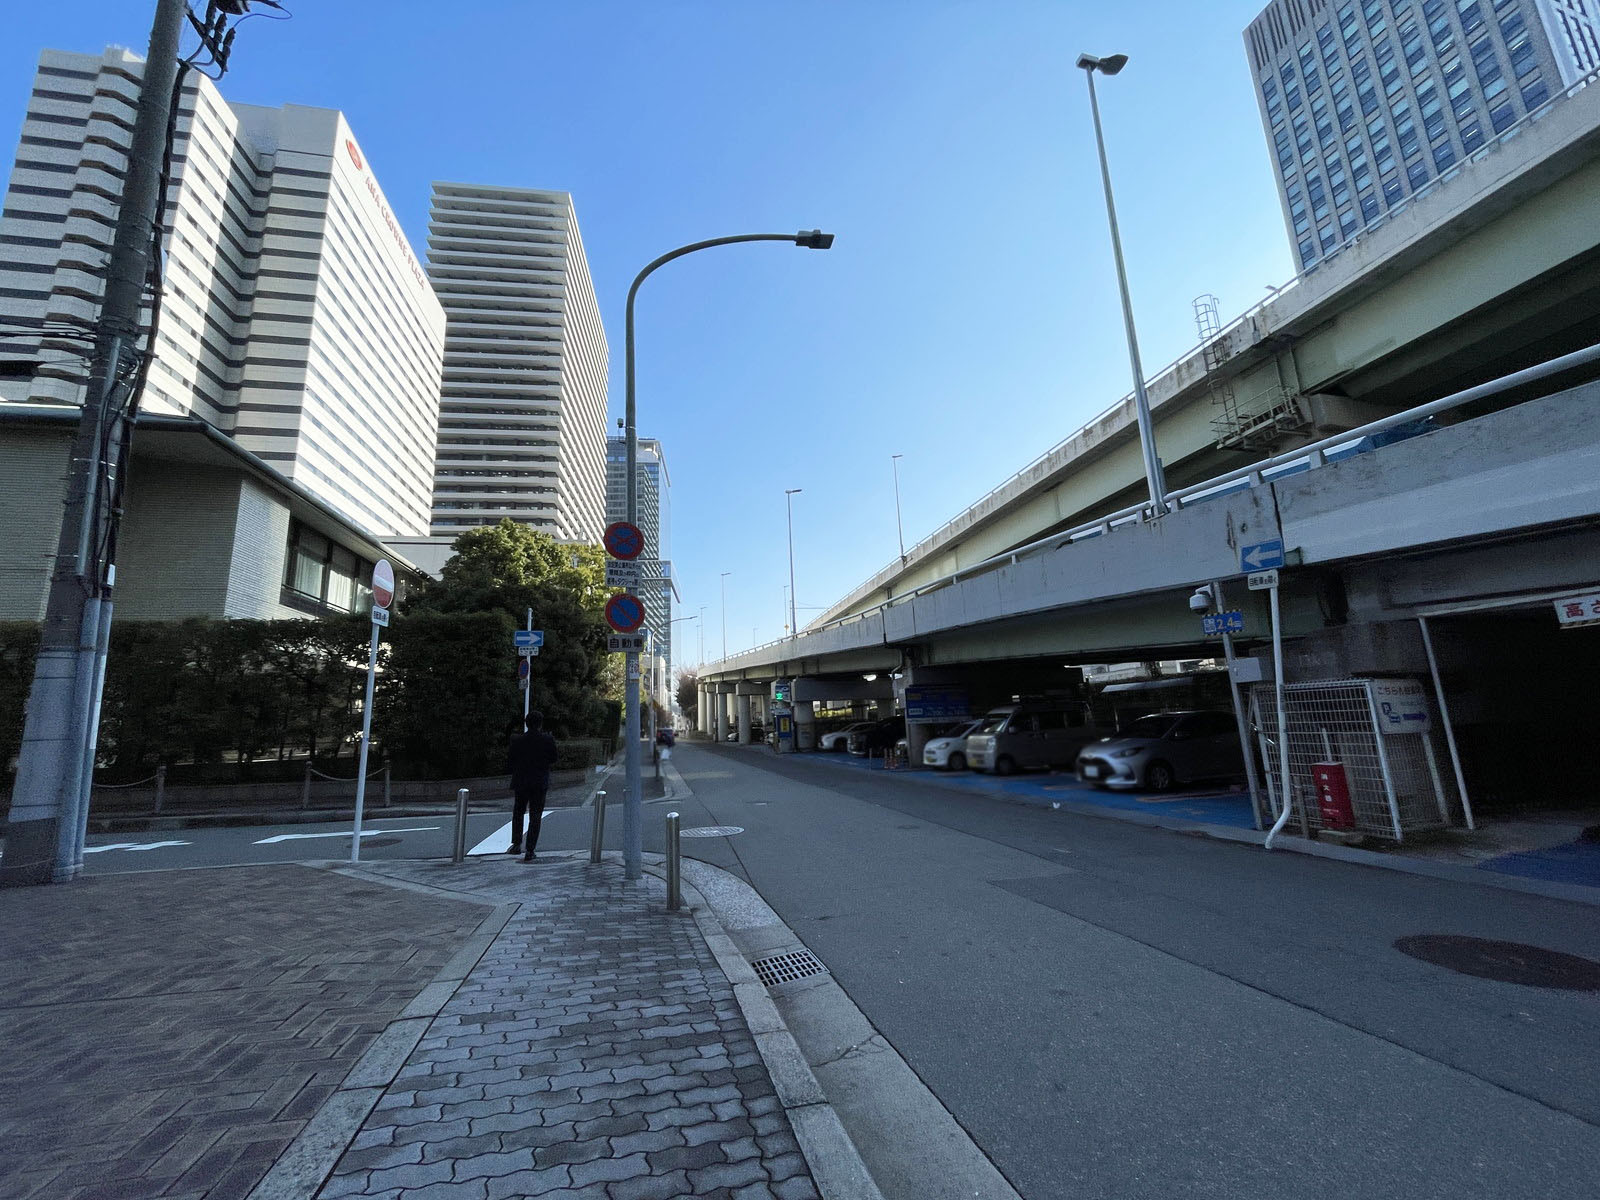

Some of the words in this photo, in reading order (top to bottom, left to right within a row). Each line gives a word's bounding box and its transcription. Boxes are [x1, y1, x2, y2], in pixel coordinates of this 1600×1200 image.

[365, 176, 380, 208] ANA
[381, 206, 407, 257] CROWNE
[408, 254, 424, 290] PLAZA
[609, 638, 642, 648] 自動車
